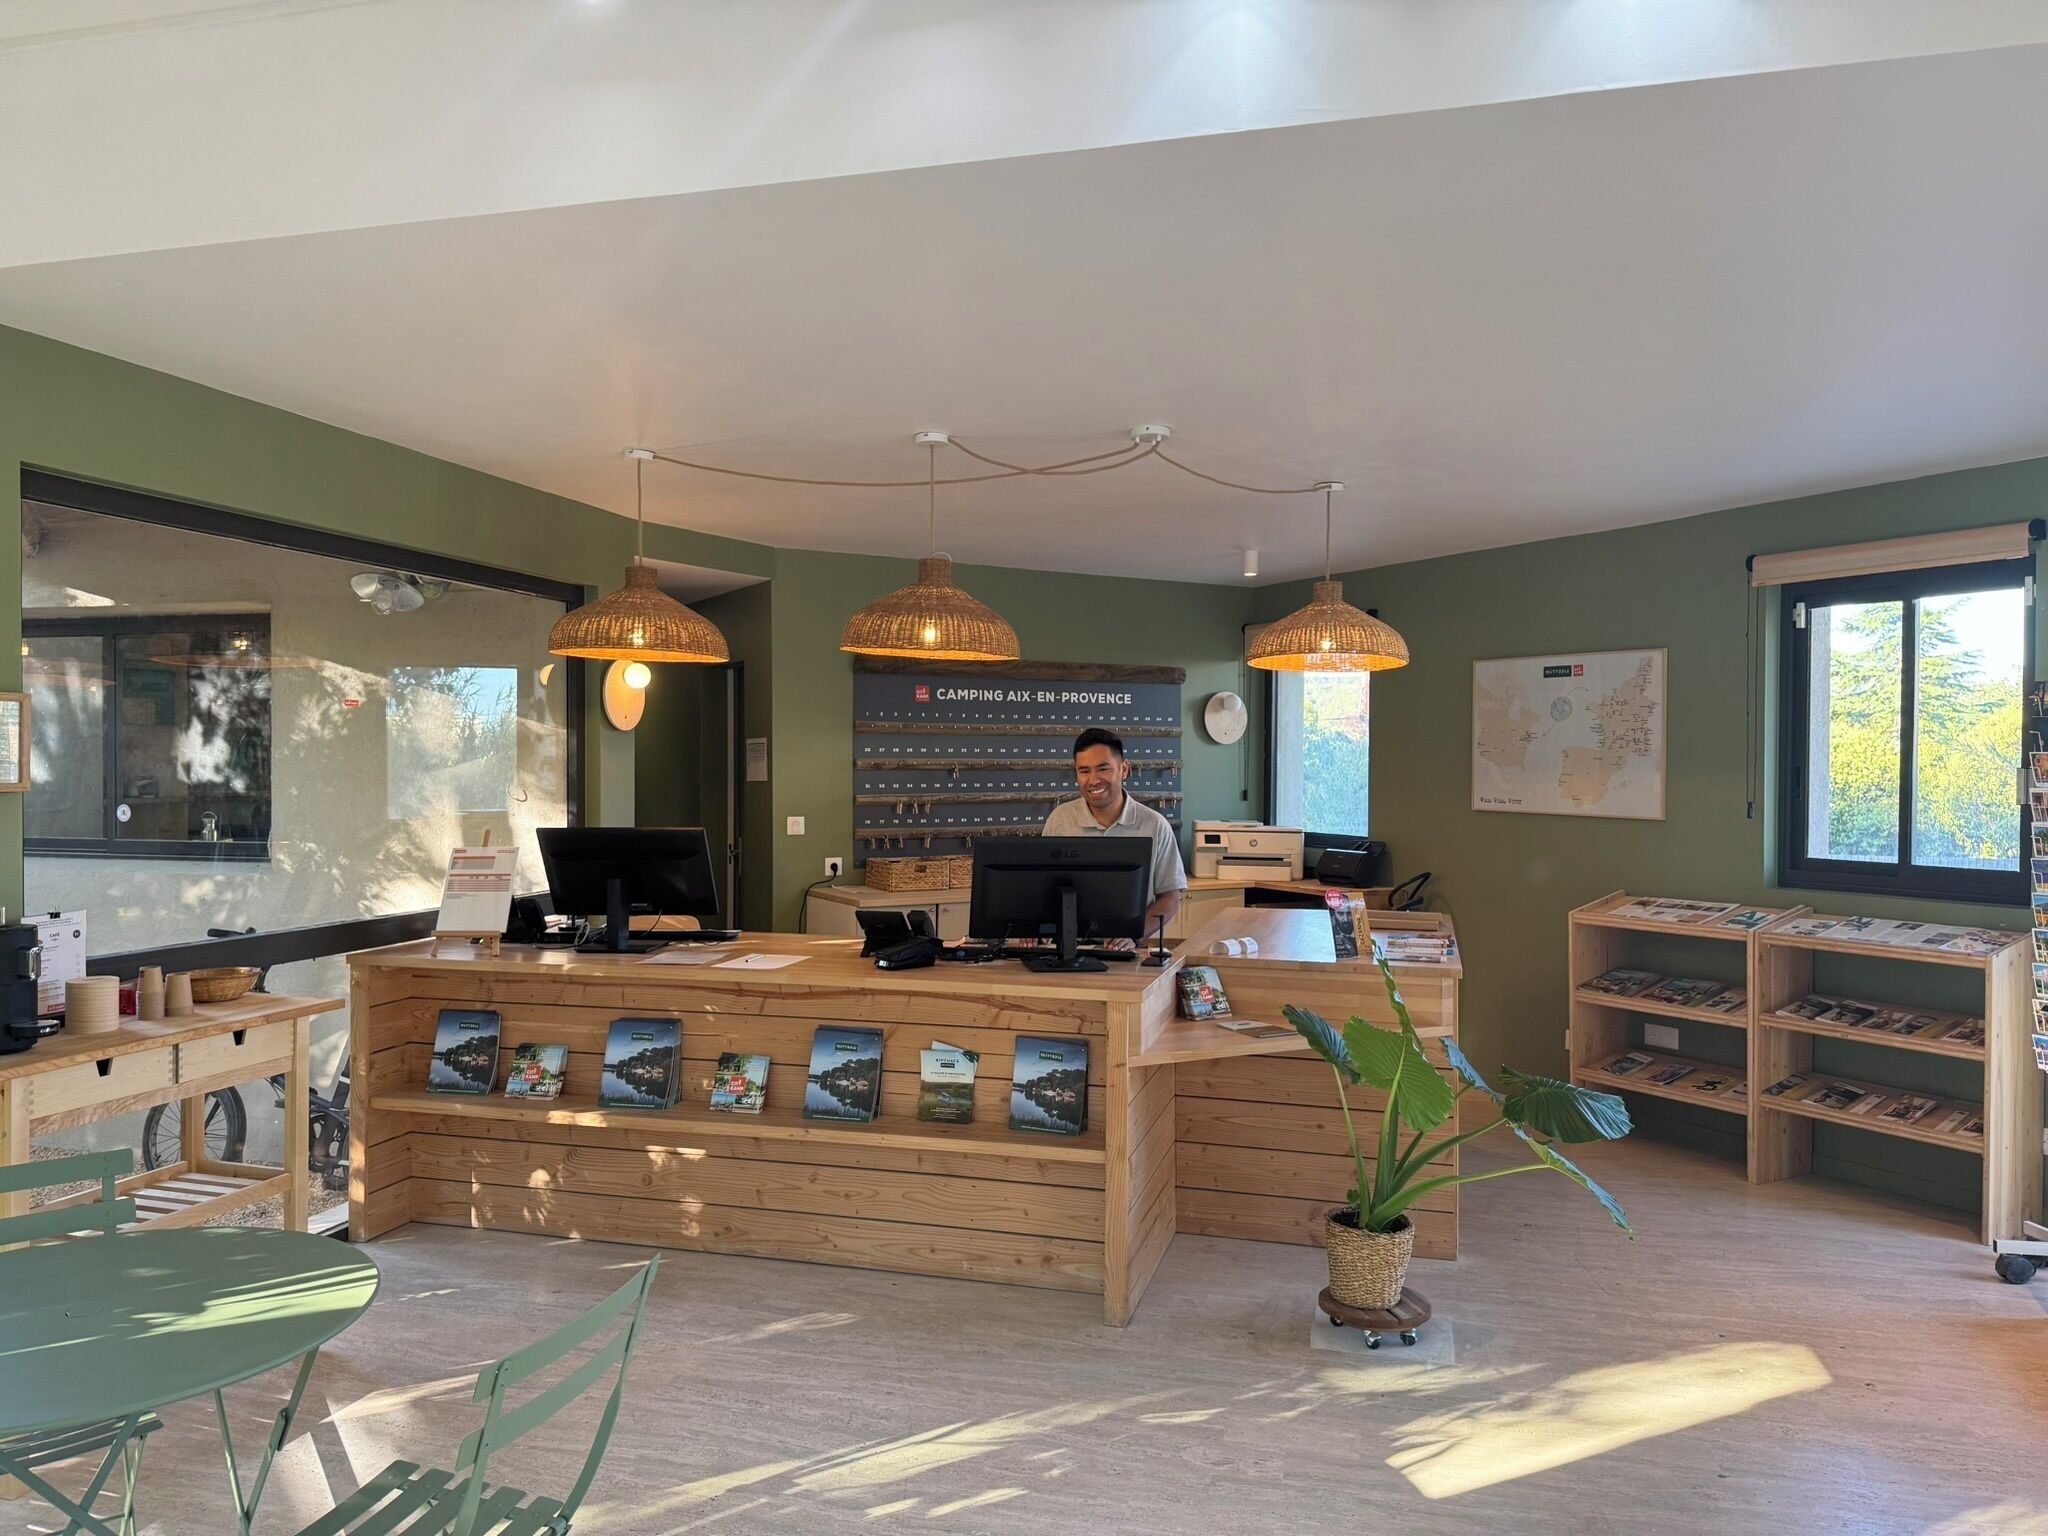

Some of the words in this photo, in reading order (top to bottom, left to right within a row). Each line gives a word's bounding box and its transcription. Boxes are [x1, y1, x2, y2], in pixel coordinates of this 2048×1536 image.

[936, 688, 1004, 701] CAMPING
[1006, 691, 1132, 704] AIX-EN-PROVENCE
[1064, 850, 1078, 858] LG
